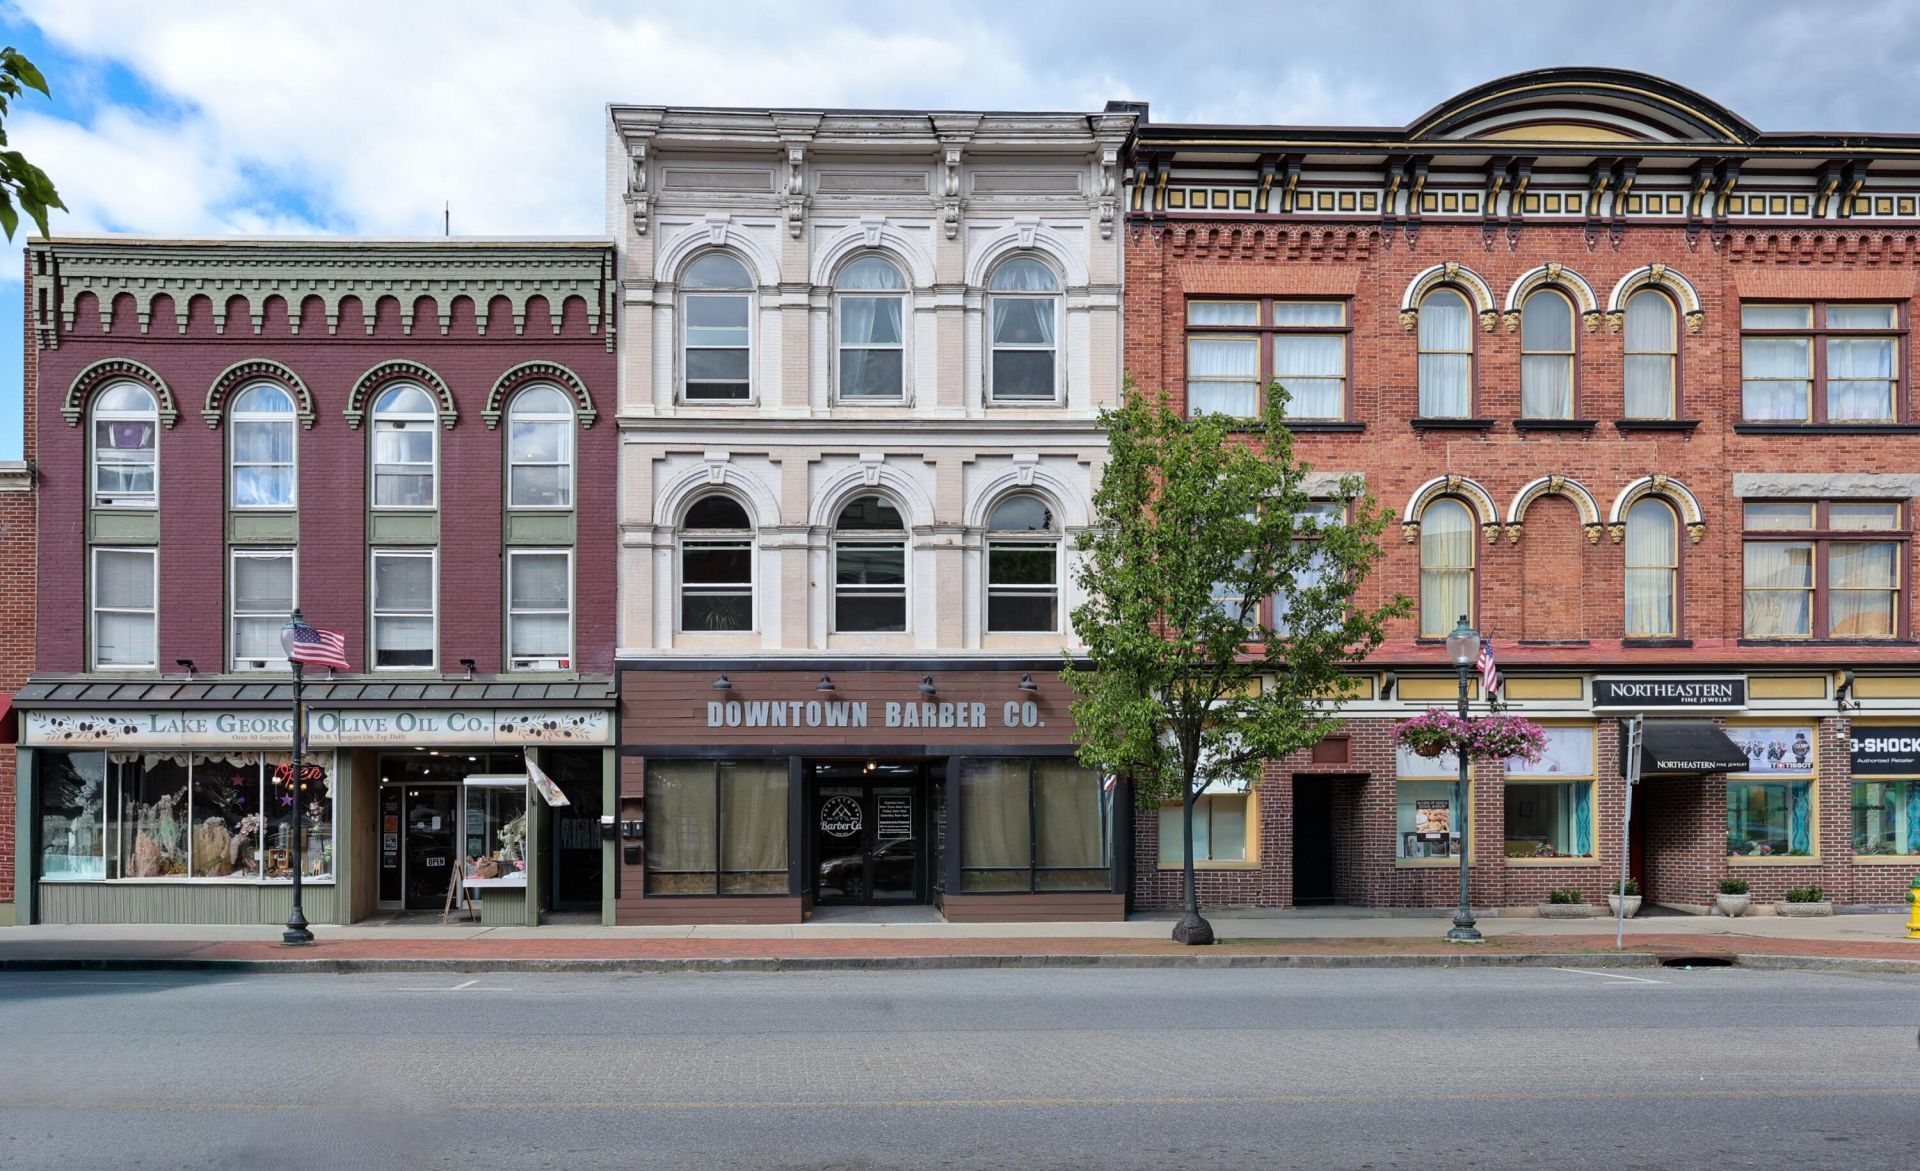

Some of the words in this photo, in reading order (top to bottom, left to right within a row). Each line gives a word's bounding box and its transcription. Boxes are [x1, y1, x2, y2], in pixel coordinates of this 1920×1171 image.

[1611, 683, 1732, 697] NORTHEASTERN
[707, 701, 868, 727] DOWNTOWN
[885, 702, 987, 728] BARBER
[1003, 701, 1045, 728] CO.
[148, 713, 208, 733] LAKE
[216, 713, 294, 733] GEORG
[317, 712, 388, 733] OLIVE
[395, 712, 439, 732] OIL
[447, 712, 490, 732] CO.
[260, 734, 291, 743] Imported
[333, 733, 361, 742] Vnegars
[390, 733, 406, 742] Daily
[1850, 738, 1920, 752] G-SHOCK
[1657, 760, 1716, 769] NORTHEASTERN
[820, 820, 851, 831] Barber
[428, 857, 445, 867] OPEN
